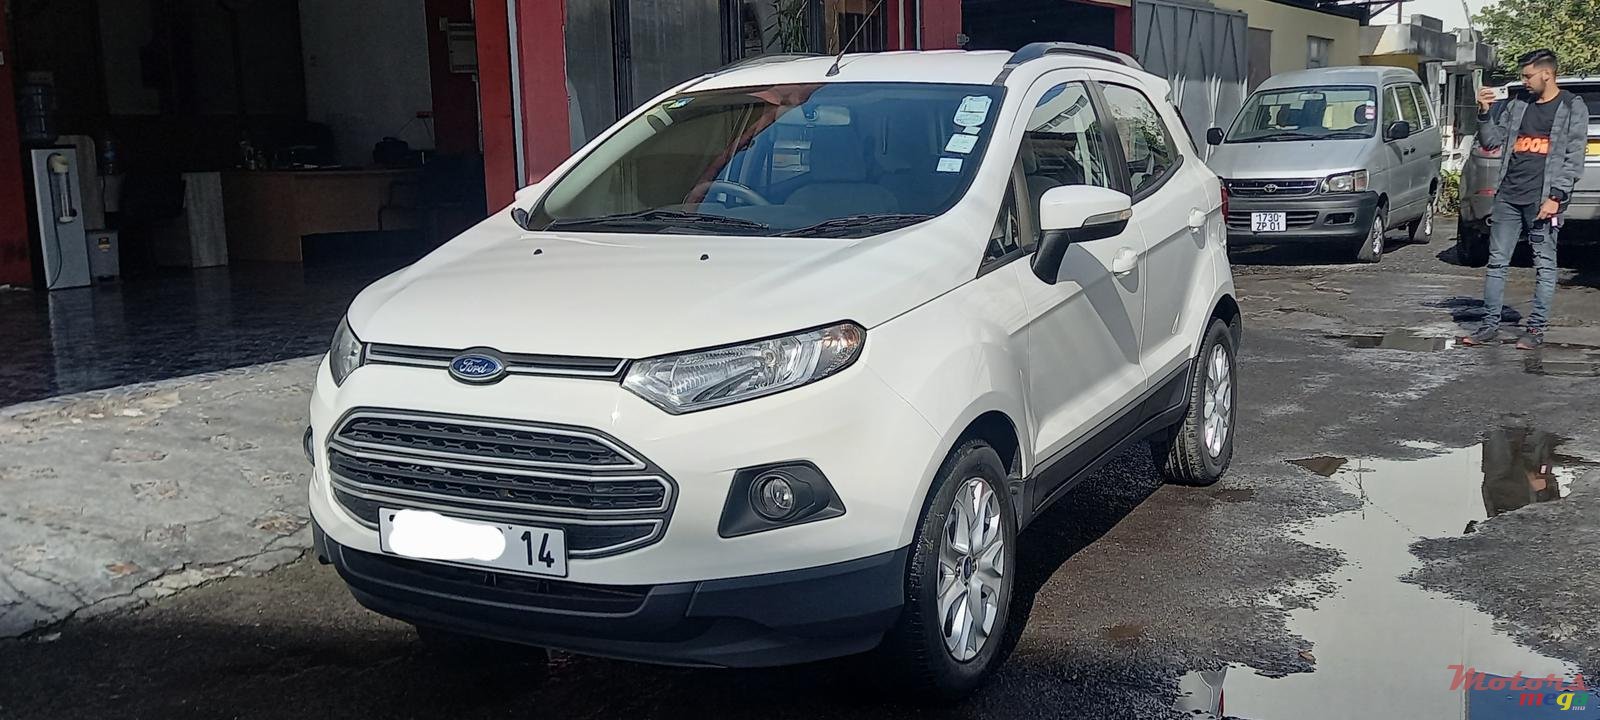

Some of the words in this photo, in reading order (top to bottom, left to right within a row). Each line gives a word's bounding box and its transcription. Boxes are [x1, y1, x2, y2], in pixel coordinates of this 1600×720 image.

[1257, 213, 1279, 222] 1730
[1256, 222, 1268, 231] ZP
[1270, 221, 1280, 231] 01
[459, 358, 489, 374] Ford
[520, 530, 555, 568] 14
